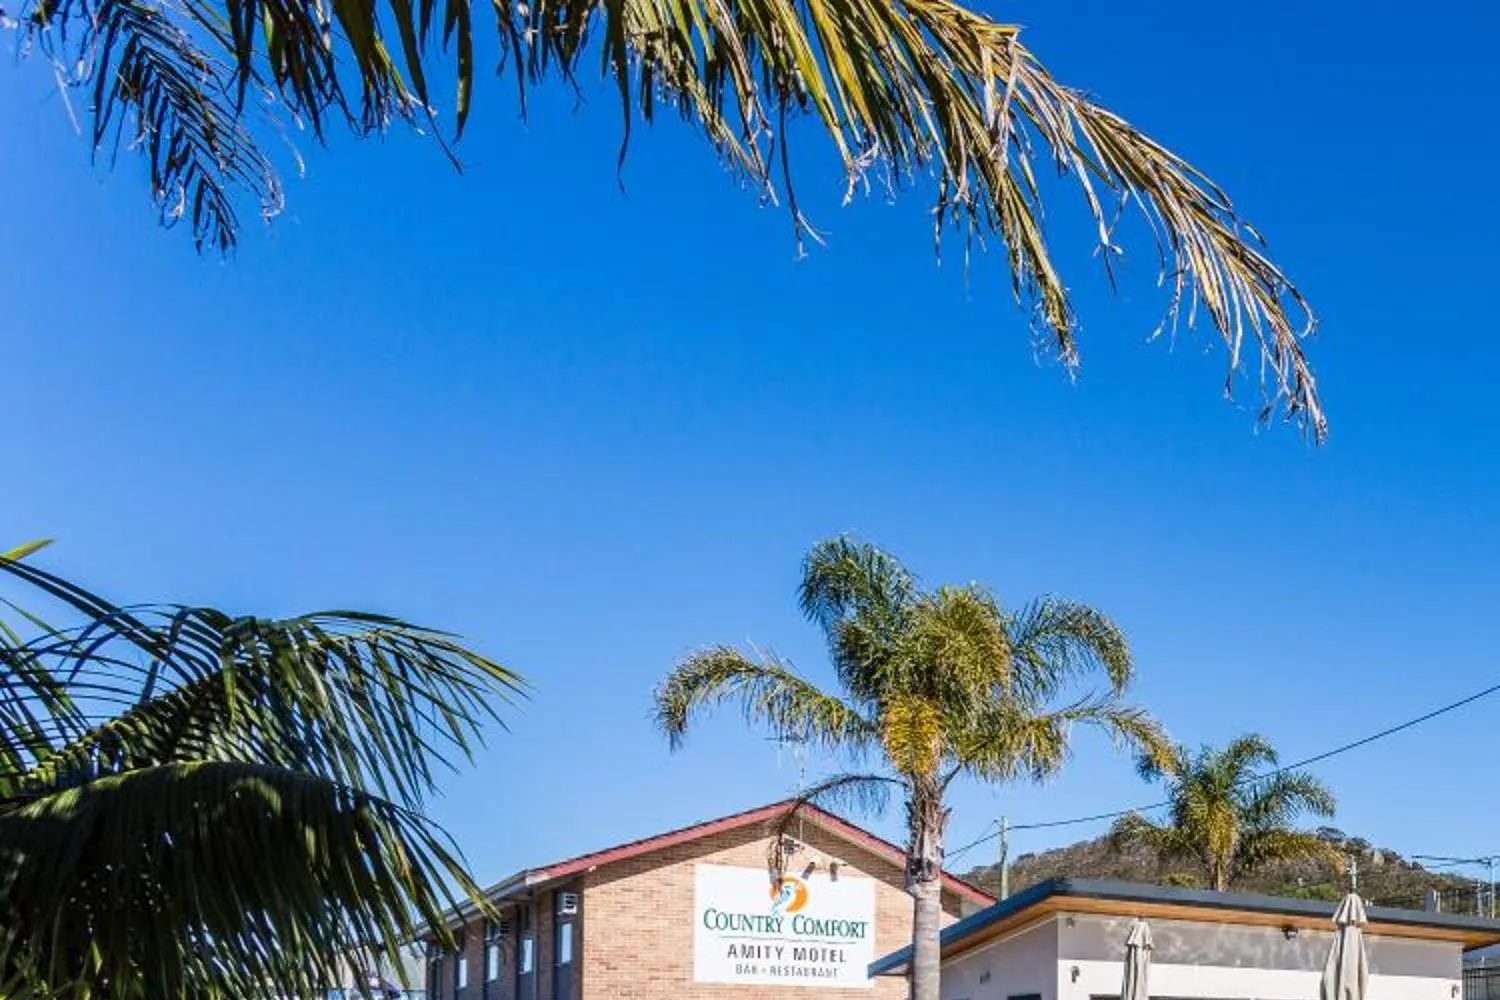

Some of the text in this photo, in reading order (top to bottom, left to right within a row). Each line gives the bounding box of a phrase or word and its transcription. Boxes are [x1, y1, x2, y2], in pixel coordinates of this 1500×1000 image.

[703, 908, 868, 938] COUNTRY COMFORT
[727, 944, 846, 963] AMITY MOTEL
[770, 965, 838, 978] RESTAURANT
